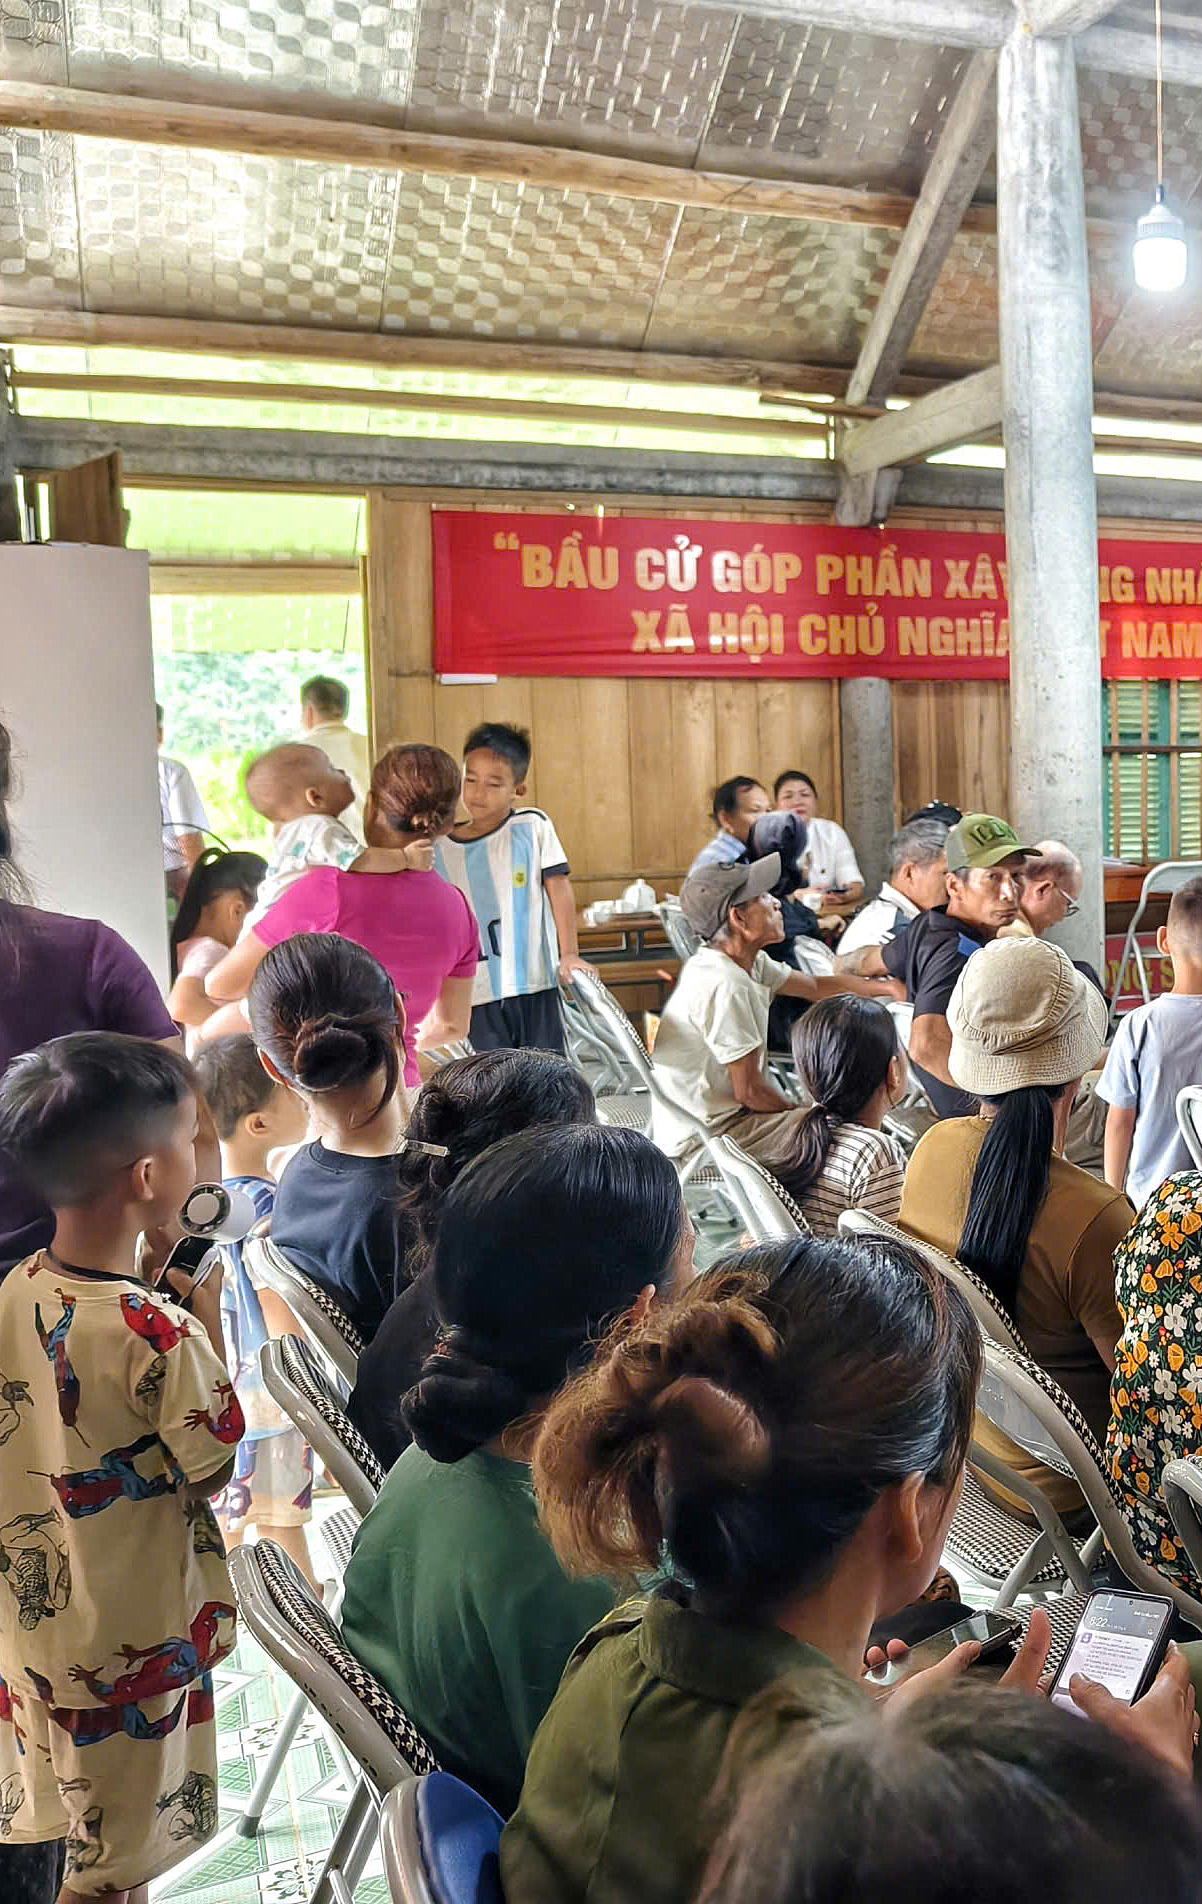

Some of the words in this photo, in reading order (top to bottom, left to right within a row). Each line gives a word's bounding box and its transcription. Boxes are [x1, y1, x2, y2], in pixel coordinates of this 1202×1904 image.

[635, 534, 703, 592] CỬ
[711, 543, 803, 594] GÓP
[631, 603, 696, 654] XÃ
[708, 604, 784, 664] HỘI
[798, 601, 886, 656] CHỦ
